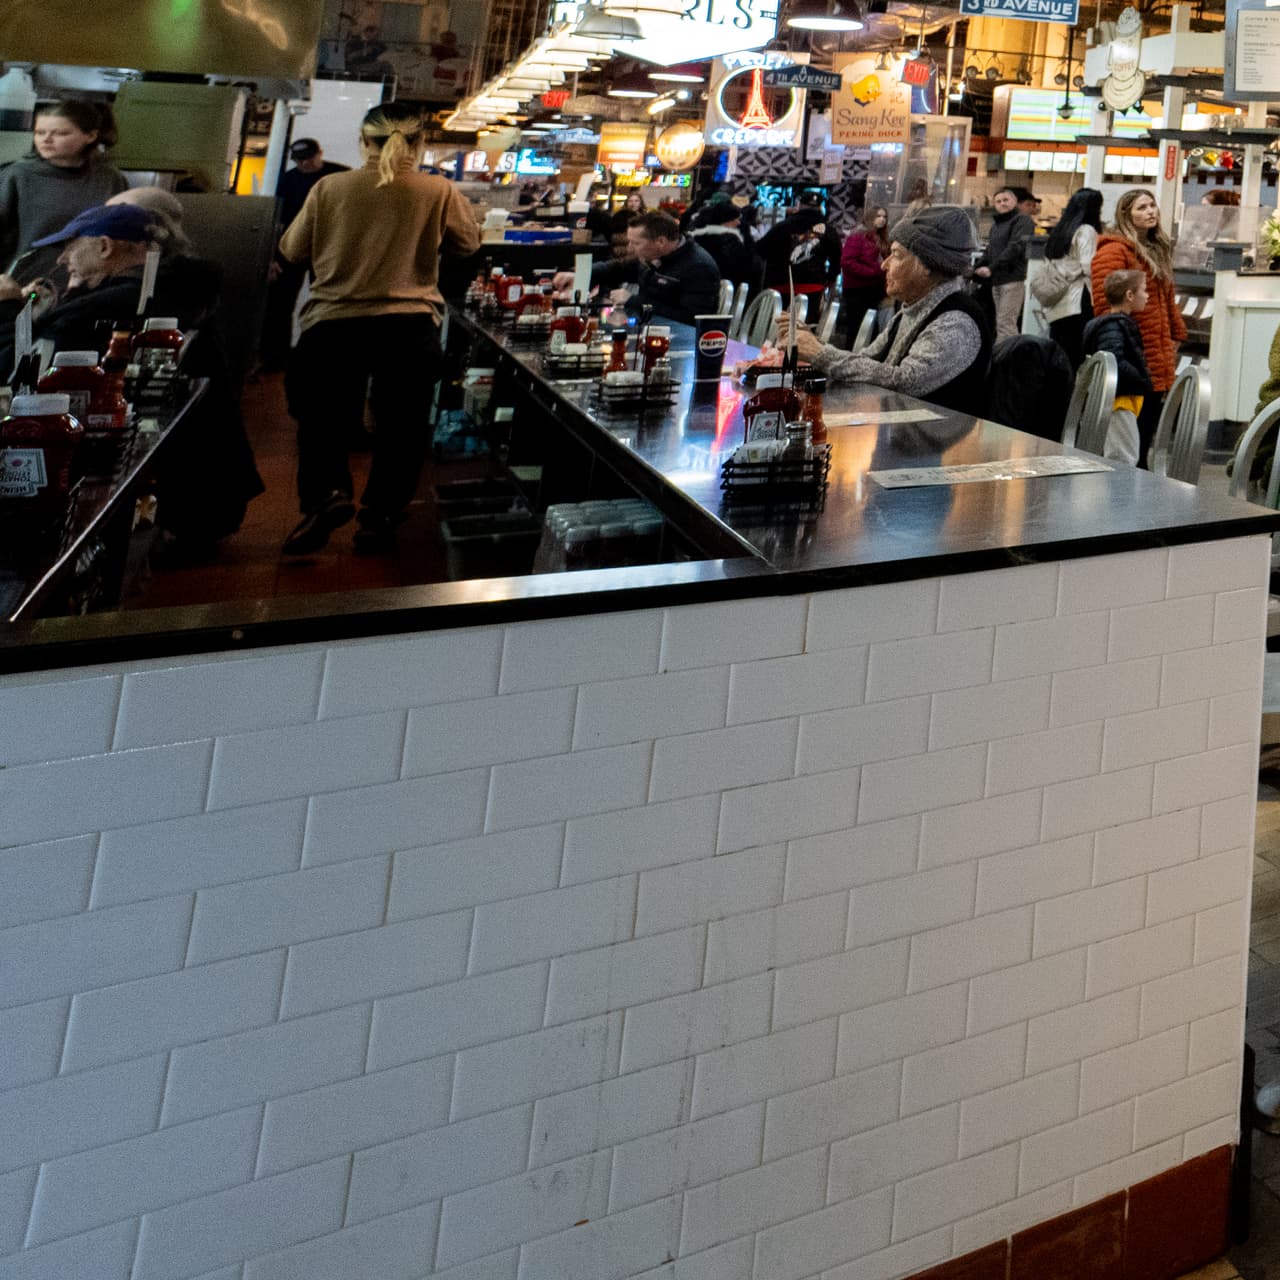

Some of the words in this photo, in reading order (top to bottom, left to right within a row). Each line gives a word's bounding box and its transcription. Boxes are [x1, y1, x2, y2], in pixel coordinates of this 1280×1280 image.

[791, 73, 840, 87] AVENUE
[906, 61, 929, 84] EXIT
[546, 91, 570, 107] EXIT
[837, 108, 879, 131] Sang
[880, 108, 906, 128] Kee
[711, 128, 795, 146] CREPERIE
[878, 130, 904, 138] DUCK
[651, 174, 691, 188] JUICES
[700, 339, 727, 349] PEPSI
